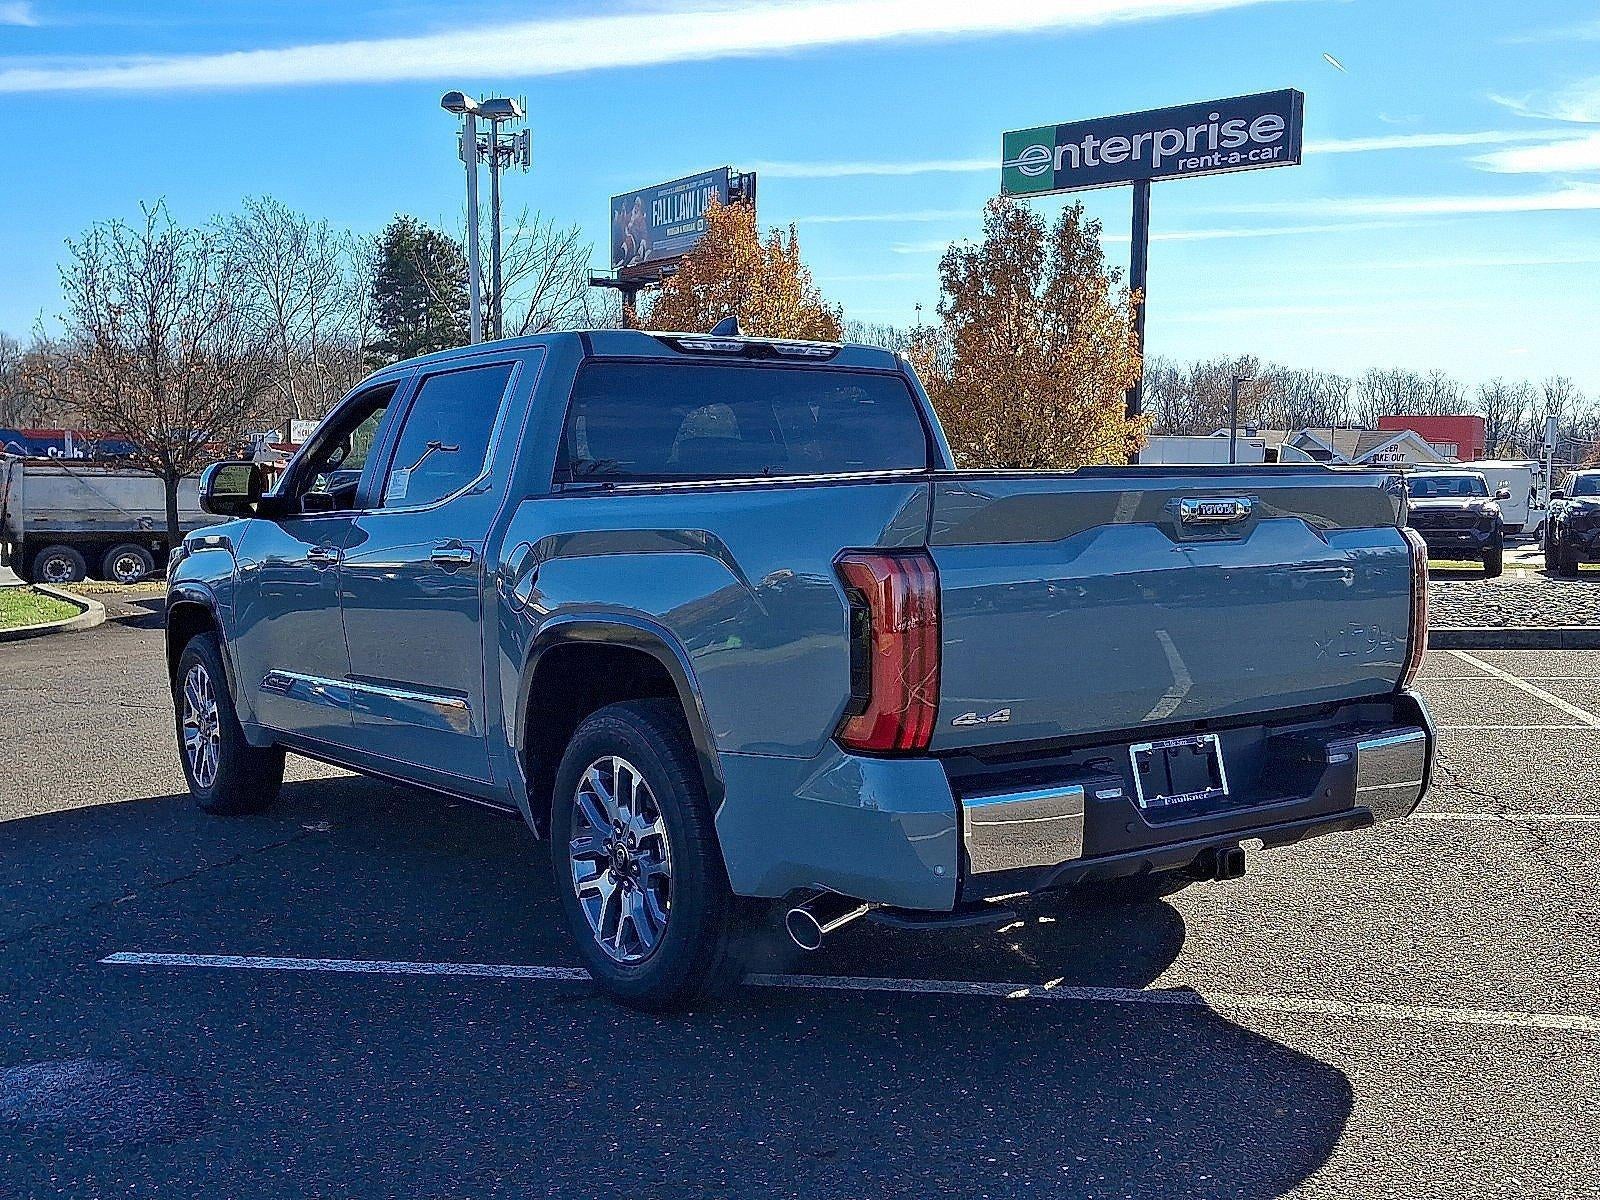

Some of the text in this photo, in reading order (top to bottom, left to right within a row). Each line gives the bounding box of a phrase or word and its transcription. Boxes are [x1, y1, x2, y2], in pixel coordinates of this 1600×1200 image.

[1016, 112, 1285, 177] enterprise
[1178, 145, 1283, 171] rent-a-car
[652, 196, 673, 228] FALL
[674, 190, 695, 222] LAW
[47, 446, 84, 458] Crb
[1391, 453, 1406, 462] OUT
[1201, 503, 1235, 514] TOYOTA
[952, 708, 1011, 726] 4x4
[1164, 793, 1209, 806] Faulkner
